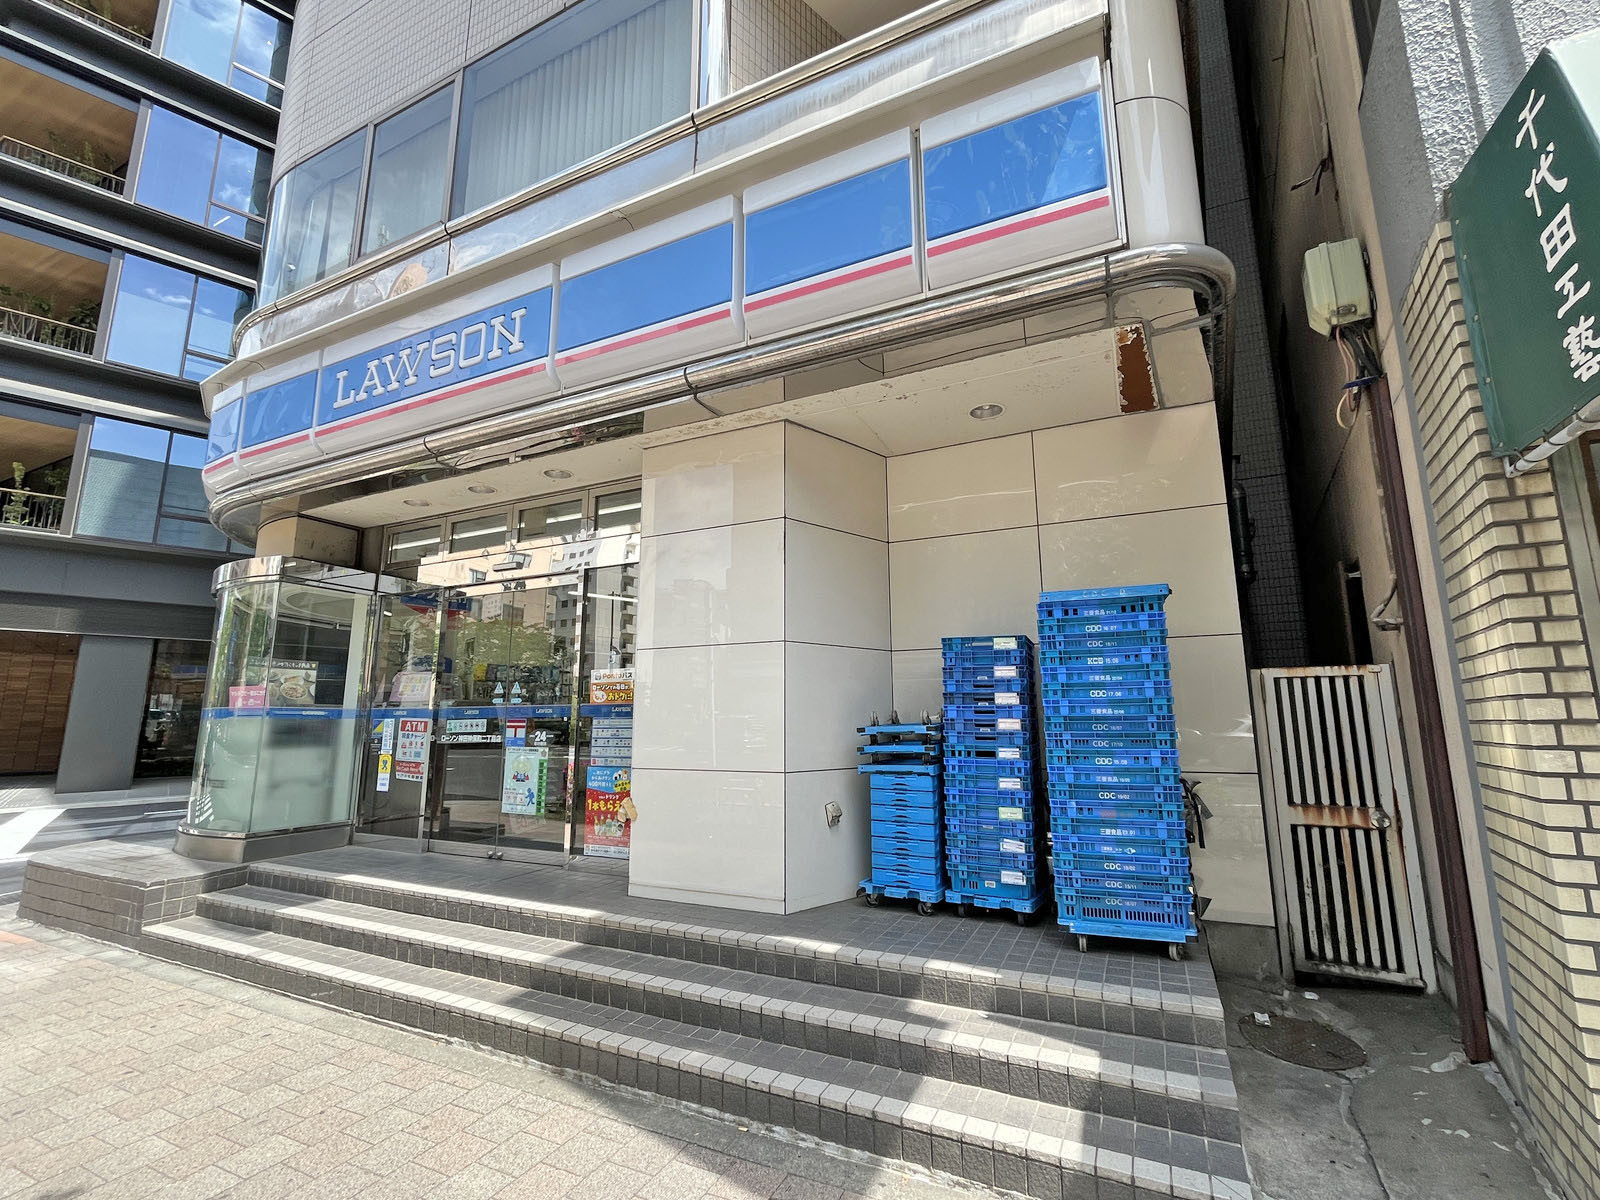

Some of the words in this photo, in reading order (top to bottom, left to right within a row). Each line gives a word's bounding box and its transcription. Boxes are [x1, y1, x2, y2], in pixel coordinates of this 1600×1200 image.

[333, 306, 527, 409] LAWSON
[1085, 624, 1102, 632] CDC
[1087, 640, 1104, 648] CDC
[1089, 689, 1107, 697] CDC
[405, 721, 425, 732] ATM
[535, 731, 547, 741] 24
[1092, 740, 1109, 748] CDC
[1095, 757, 1112, 765] CDC
[1098, 792, 1116, 800] CDC
[1104, 863, 1121, 871] CDC
[1105, 880, 1123, 889] CDC
[1105, 898, 1123, 906] CDC
